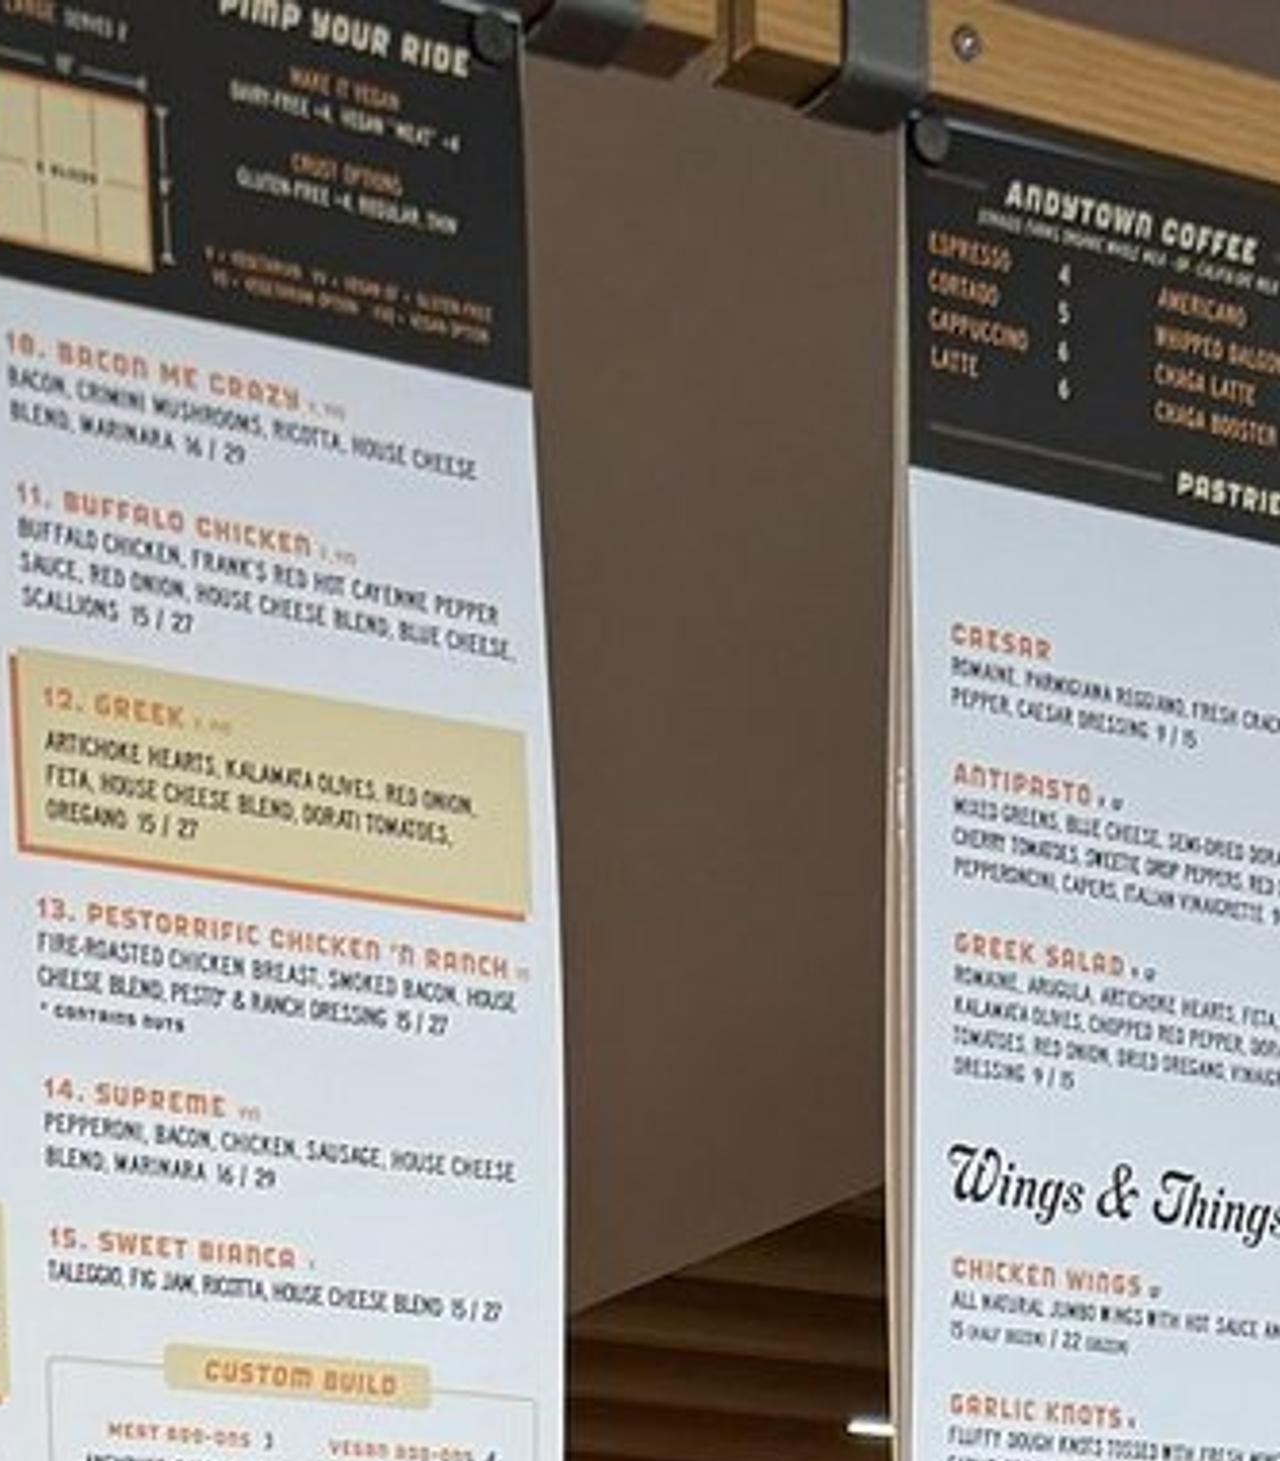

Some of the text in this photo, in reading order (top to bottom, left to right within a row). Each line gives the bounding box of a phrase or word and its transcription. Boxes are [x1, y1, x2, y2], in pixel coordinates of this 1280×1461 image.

[219, 0, 472, 78] PIMP YOUR RIDE
[1004, 177, 1153, 241] ANDYTOWN
[1160, 215, 1258, 267] COFFEE
[4, 328, 300, 413] 10. BACON ME CRAZY
[16, 479, 312, 559] 11. BUFFALO CHICKEN
[950, 621, 1051, 662] CAESAR
[42, 682, 186, 731] 12. GREEK
[953, 761, 1092, 807] ANTIPASTO
[953, 930, 1124, 978] GREEK SALAD
[44, 1076, 226, 1120] 14. SUPREME
[947, 1143, 1085, 1231] Wings
[1096, 1160, 1140, 1222] &
[49, 1224, 295, 1272] 15. SWEET BIANCA
[951, 1255, 1142, 1298] CHICKEN WINGS
[204, 1357, 398, 1398] CUSTOM BUILD
[949, 1392, 1122, 1430] GARLIC KNOTS
